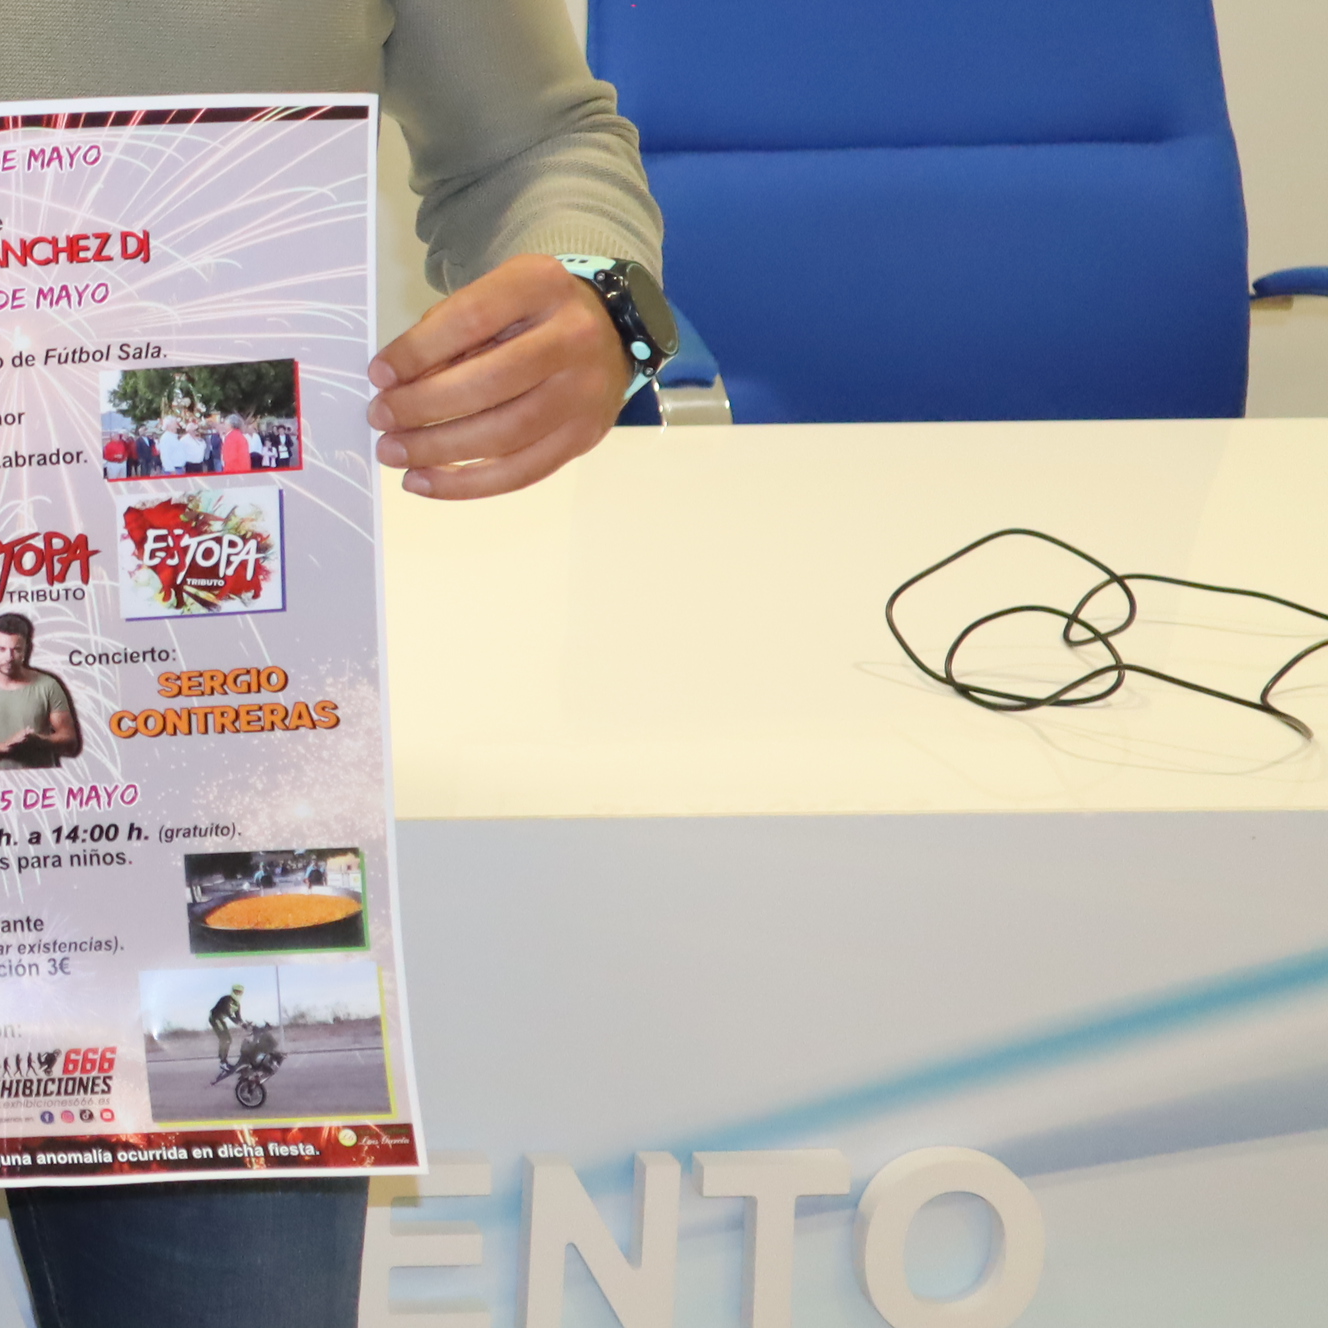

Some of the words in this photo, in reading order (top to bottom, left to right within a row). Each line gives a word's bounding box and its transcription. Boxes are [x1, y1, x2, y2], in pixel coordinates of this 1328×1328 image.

[27, 145, 102, 171] MAYO
[120, 230, 150, 262] DJ
[36, 282, 110, 309] MAYO
[11, 350, 36, 368] de
[44, 345, 111, 366] Fútbol
[118, 342, 167, 361] Sala.
[144, 528, 263, 585] ESTOPA
[7, 588, 86, 604] TRIBUTO
[186, 578, 225, 588] TRIBUTO
[68, 646, 177, 667] Concierto:
[157, 665, 288, 698] SERGIO
[109, 701, 339, 738] CONTRERAS
[22, 788, 56, 810] DE
[66, 783, 138, 810] MAYO
[27, 830, 42, 845] a
[51, 824, 120, 845] 14:00
[127, 823, 149, 842] h.
[158, 822, 242, 845] (gratuito).
[18, 852, 62, 874] para
[69, 848, 133, 867] niños.
[17, 934, 124, 956] existencias).
[47, 957, 71, 977] 3€
[62, 1046, 118, 1075] 666
[37, 1147, 112, 1164] anomalía
[117, 1146, 188, 1162] ocurrida
[193, 1148, 213, 1159] en
[218, 1143, 264, 1158] dicha
[268, 1142, 320, 1157] fiesta.
